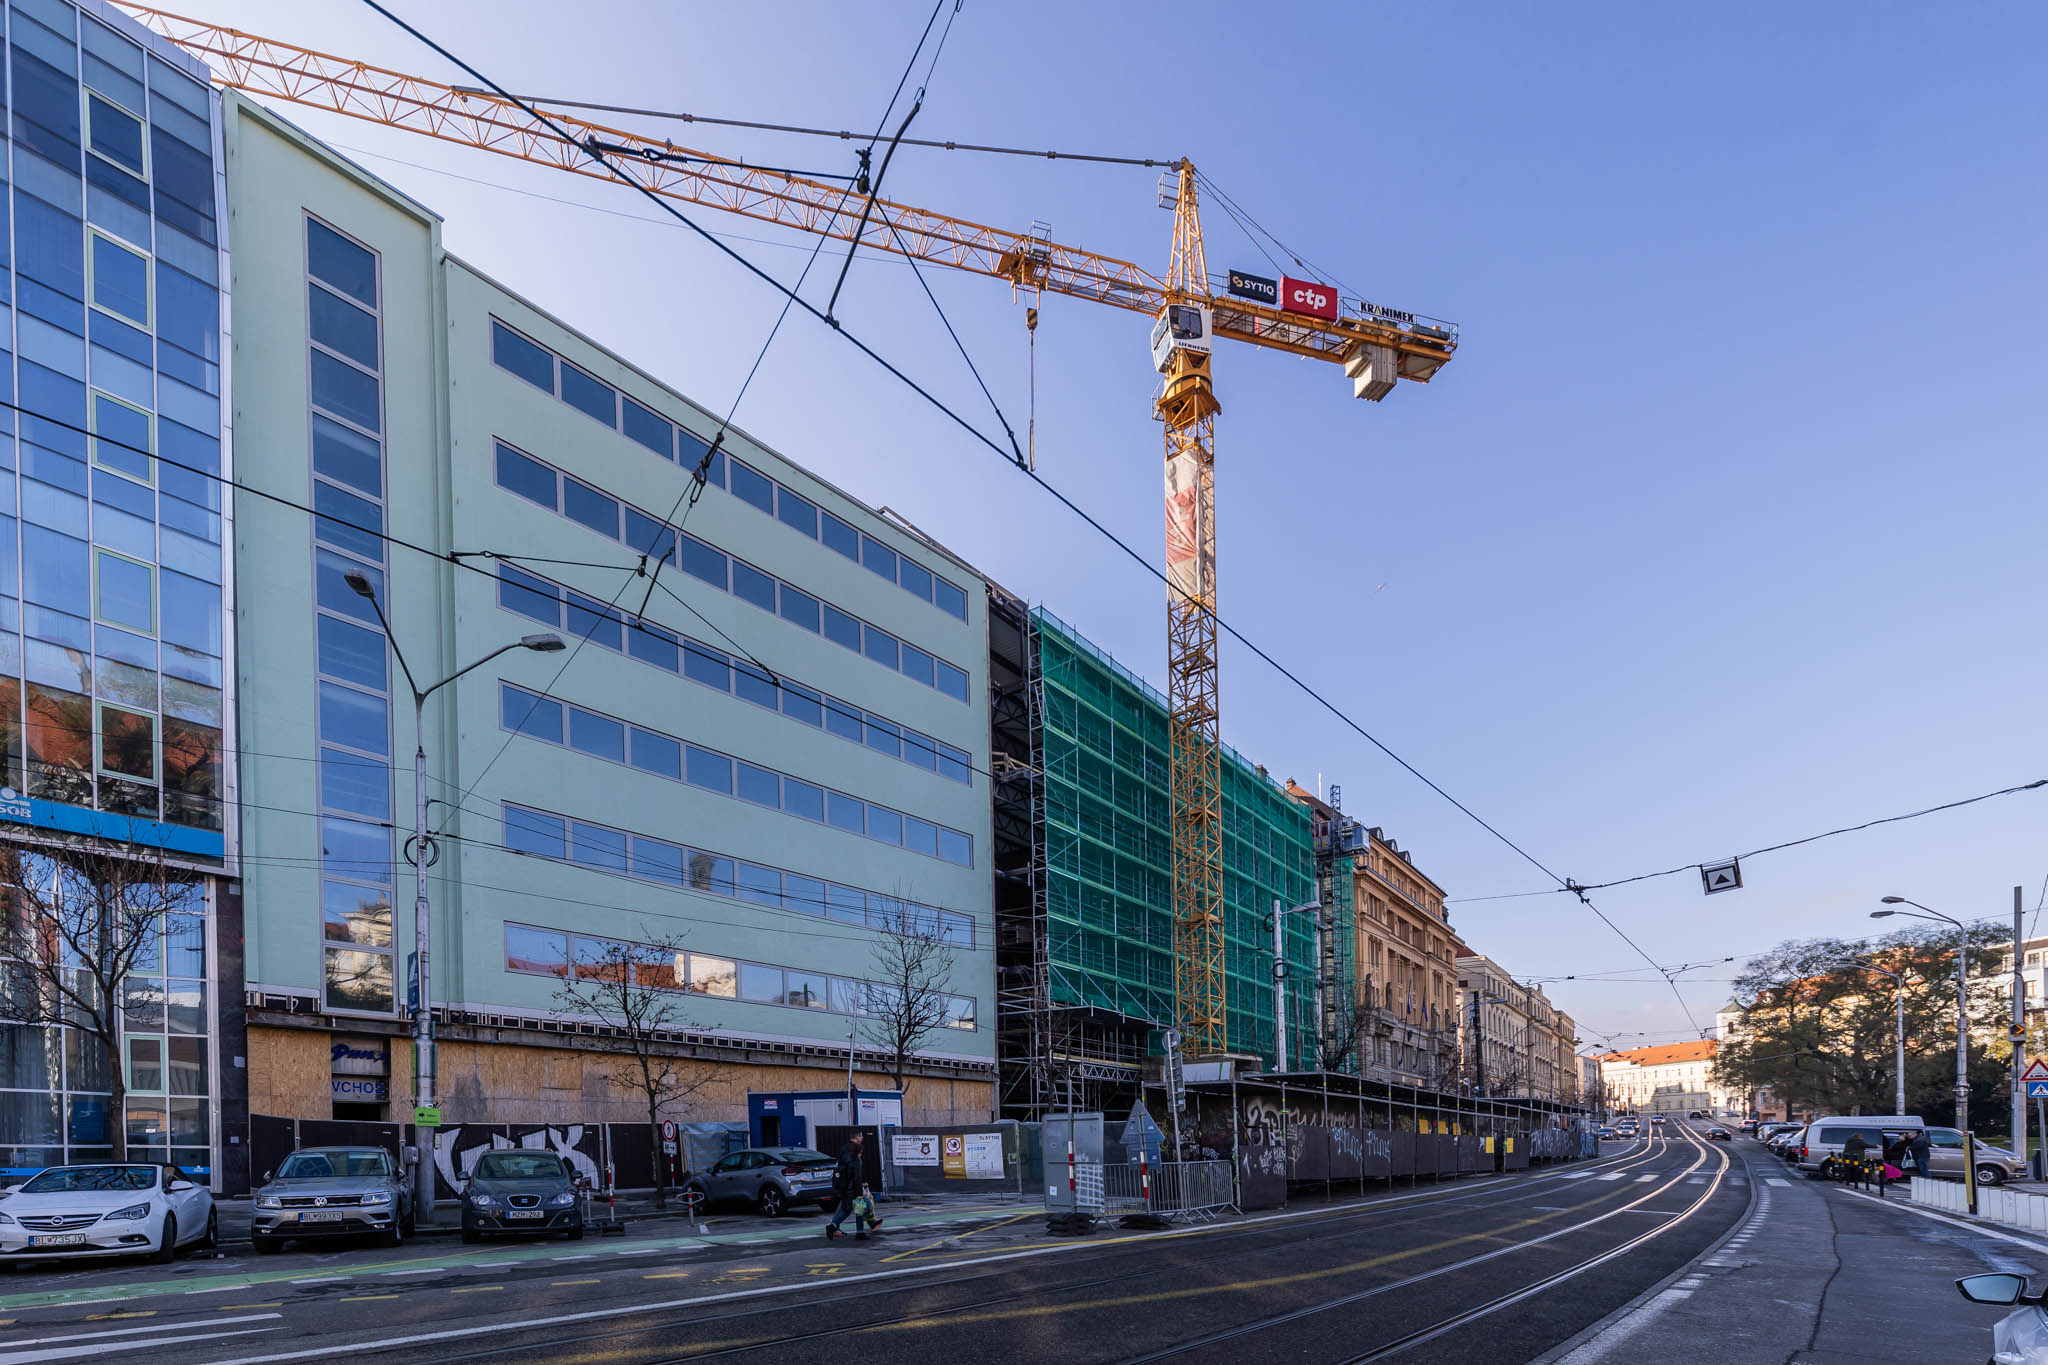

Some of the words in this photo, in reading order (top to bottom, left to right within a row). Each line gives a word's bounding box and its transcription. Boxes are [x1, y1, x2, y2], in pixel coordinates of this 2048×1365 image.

[1244, 279, 1275, 297] SYTIQ
[1294, 288, 1327, 310] ctp
[1360, 301, 1414, 323] KRANIMEX
[332, 1081, 386, 1095] VCHOD
